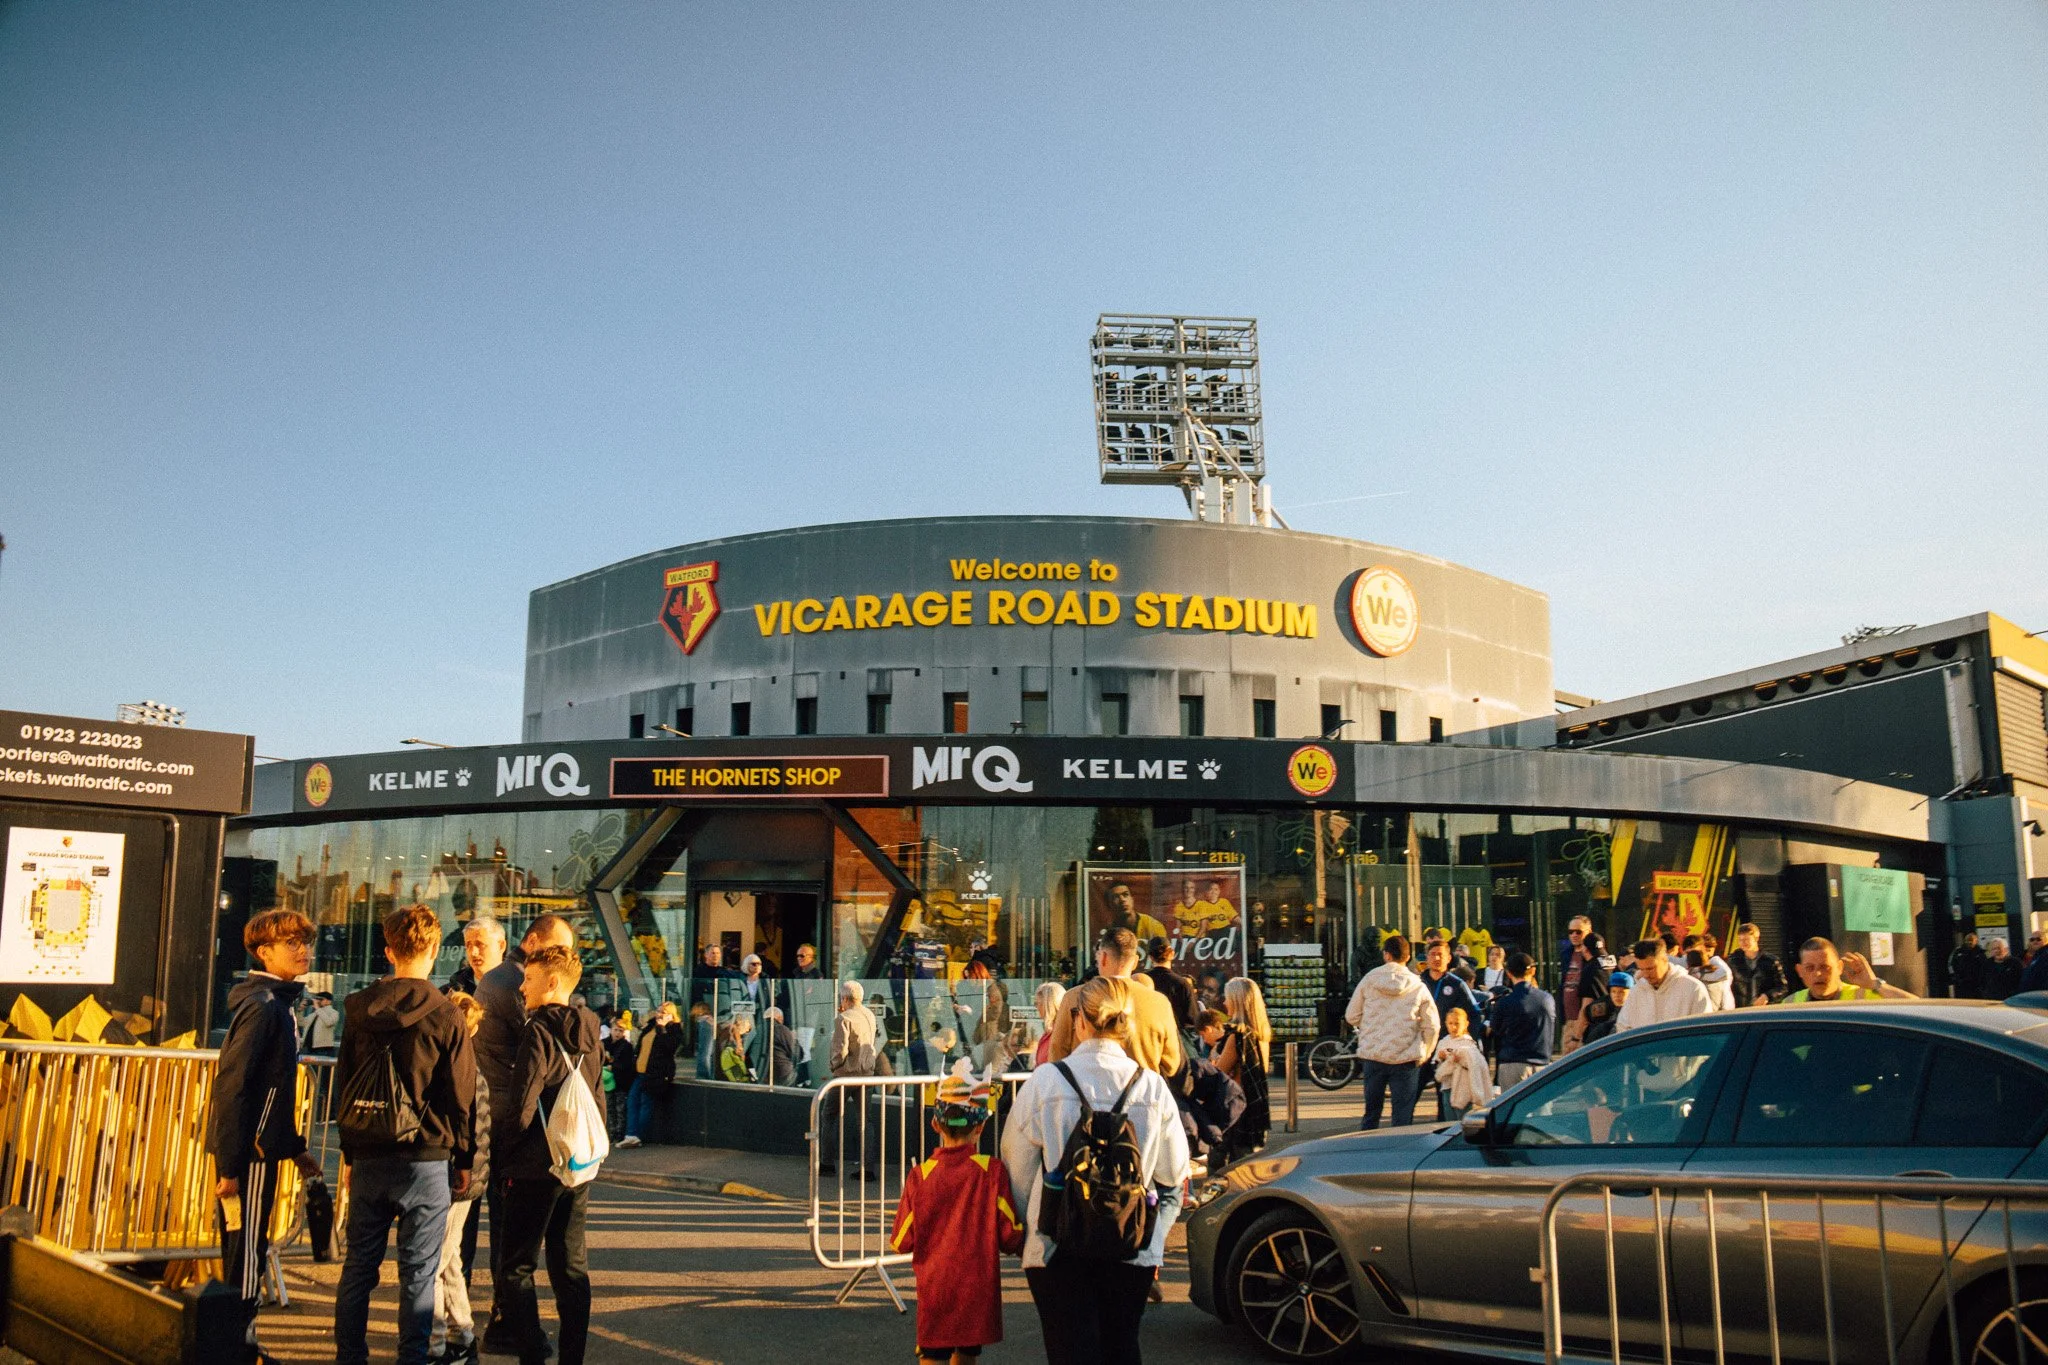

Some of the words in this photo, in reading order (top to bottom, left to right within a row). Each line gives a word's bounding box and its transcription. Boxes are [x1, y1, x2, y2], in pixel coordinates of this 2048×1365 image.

[950, 558, 1081, 581] Welcome
[1090, 559, 1118, 582] to
[754, 590, 972, 637] VICARAGE
[989, 589, 1121, 625] ROAD
[1134, 591, 1317, 638] STADIUM
[1367, 594, 1408, 628] We
[20, 725, 75, 743] 01923
[79, 731, 143, 750] 223023
[369, 769, 449, 792] KELME
[496, 752, 591, 798] MrQ
[652, 769, 685, 787] THE
[691, 767, 780, 787] HORNETS
[785, 767, 842, 787] SHOP
[911, 745, 1034, 794] MrQ
[1062, 758, 1189, 780] KELME
[1297, 762, 1328, 781] We
[309, 777, 326, 794] We
